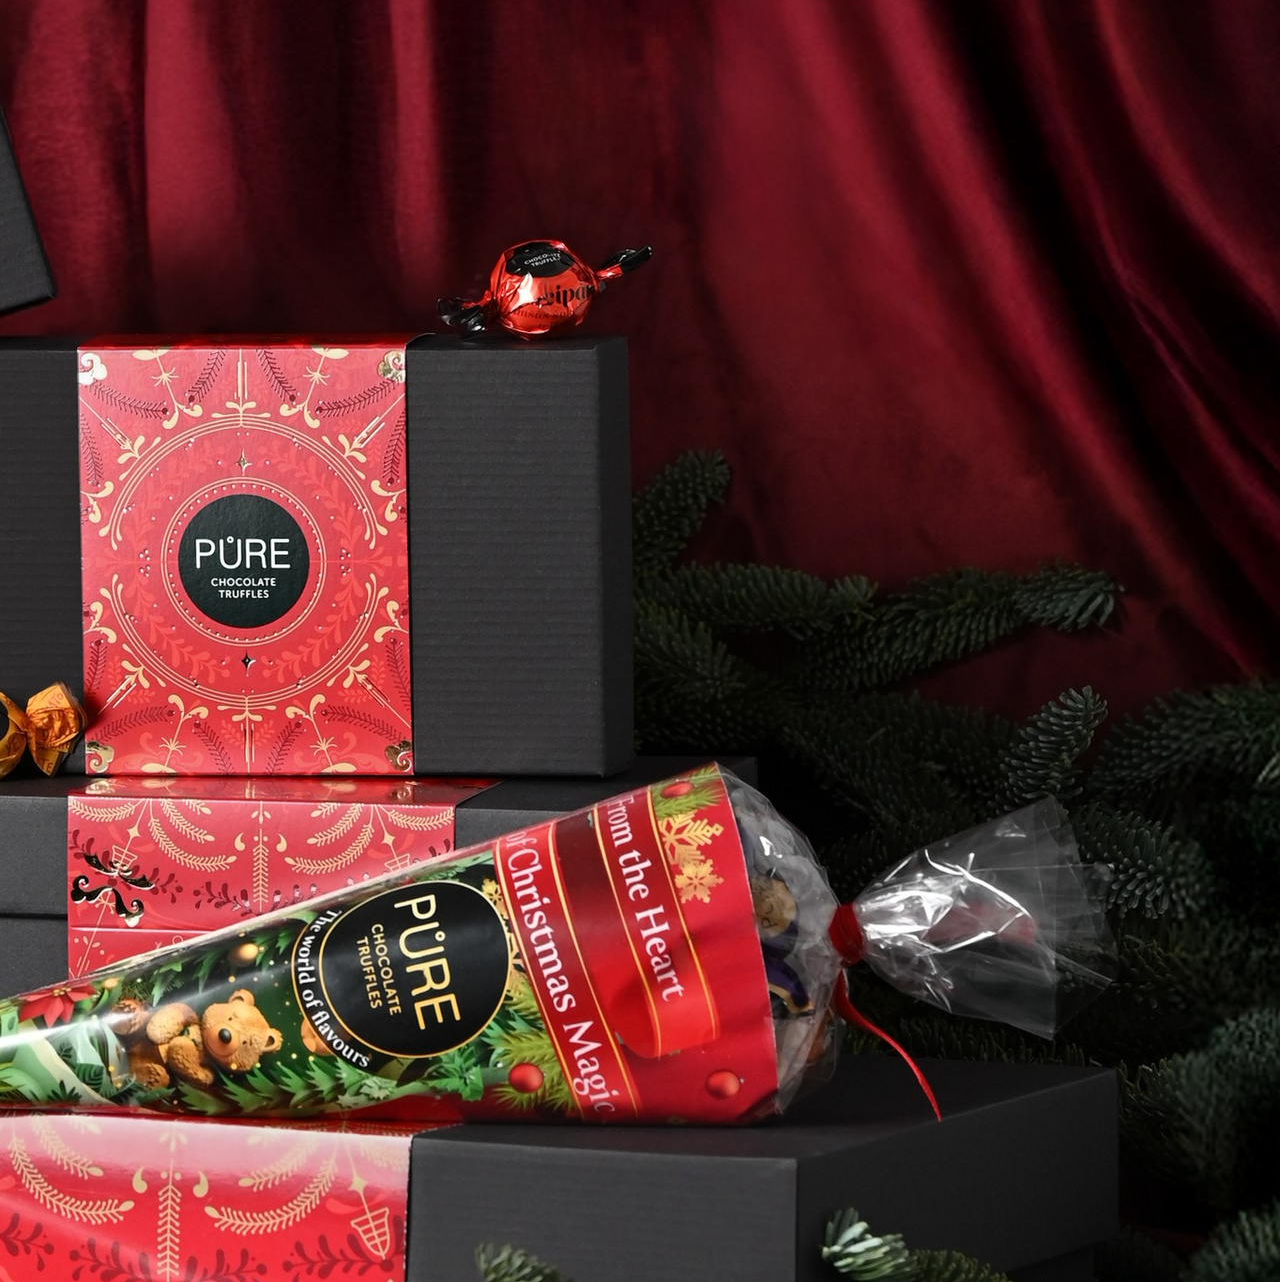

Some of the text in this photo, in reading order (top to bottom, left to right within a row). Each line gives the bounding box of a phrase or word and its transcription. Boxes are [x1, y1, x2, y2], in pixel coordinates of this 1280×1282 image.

[211, 577, 277, 587] CHOCOLATE
[218, 589, 269, 599] TRUFFLES
[607, 796, 684, 1002] From the Heart
[297, 909, 370, 1068] The world of flavours
[357, 936, 383, 1009] TRUFFLES
[371, 923, 402, 1016] CHOCOLATE
[505, 830, 620, 1114] of Christmas Magic
